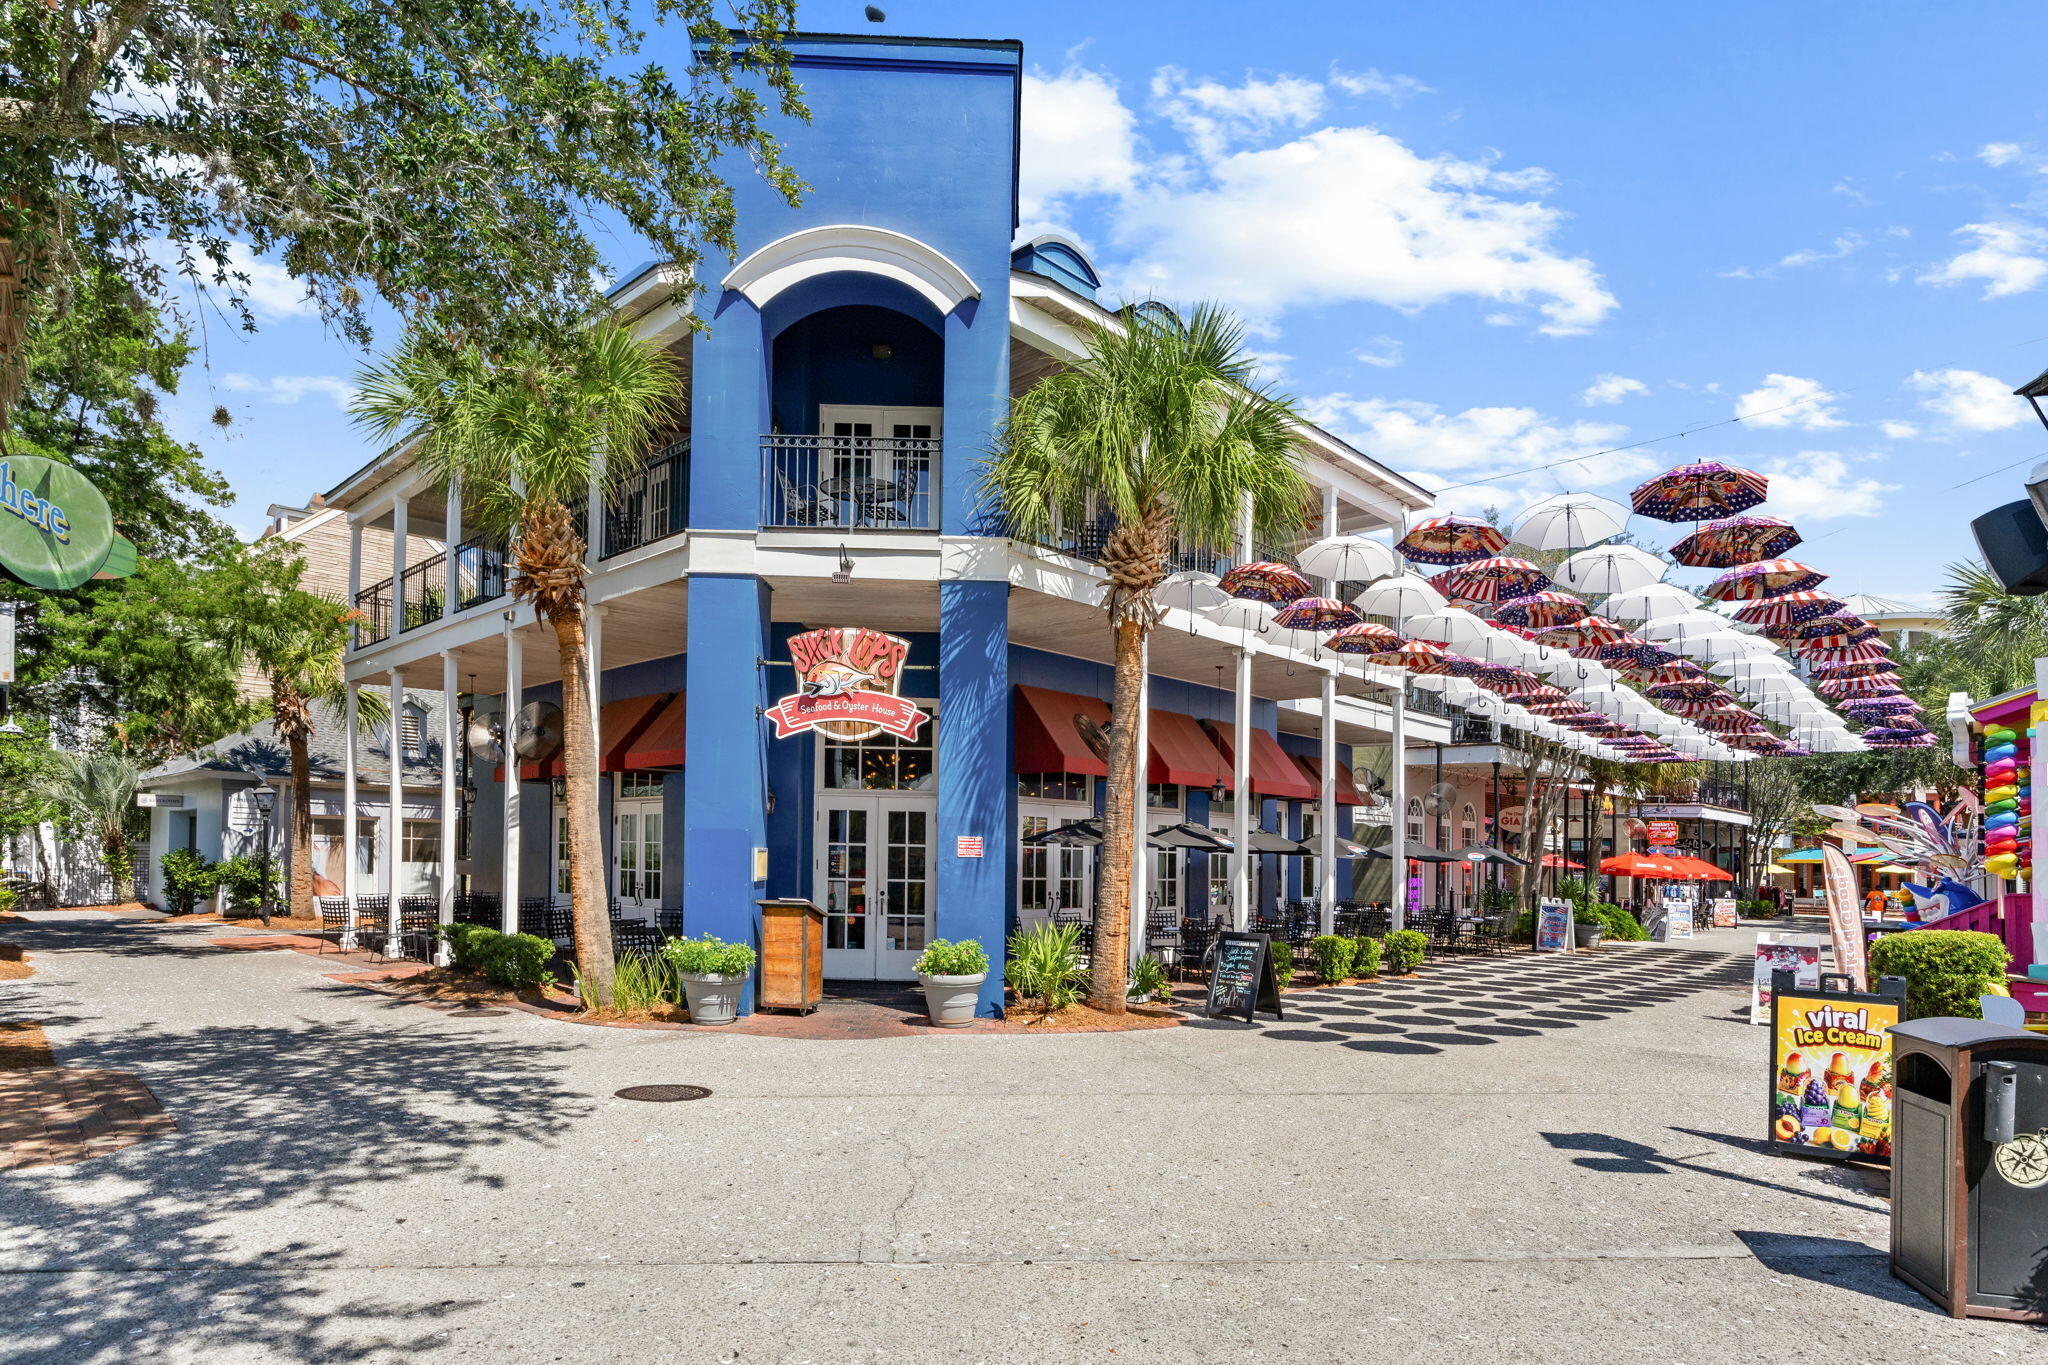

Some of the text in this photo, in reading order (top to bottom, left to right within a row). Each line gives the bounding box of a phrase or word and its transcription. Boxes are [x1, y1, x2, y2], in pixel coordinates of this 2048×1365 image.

[800, 700, 896, 716] Seafood & Oyster House
[1807, 1005, 1867, 1031] viral
[1796, 1027, 1881, 1048] Ice Cream
